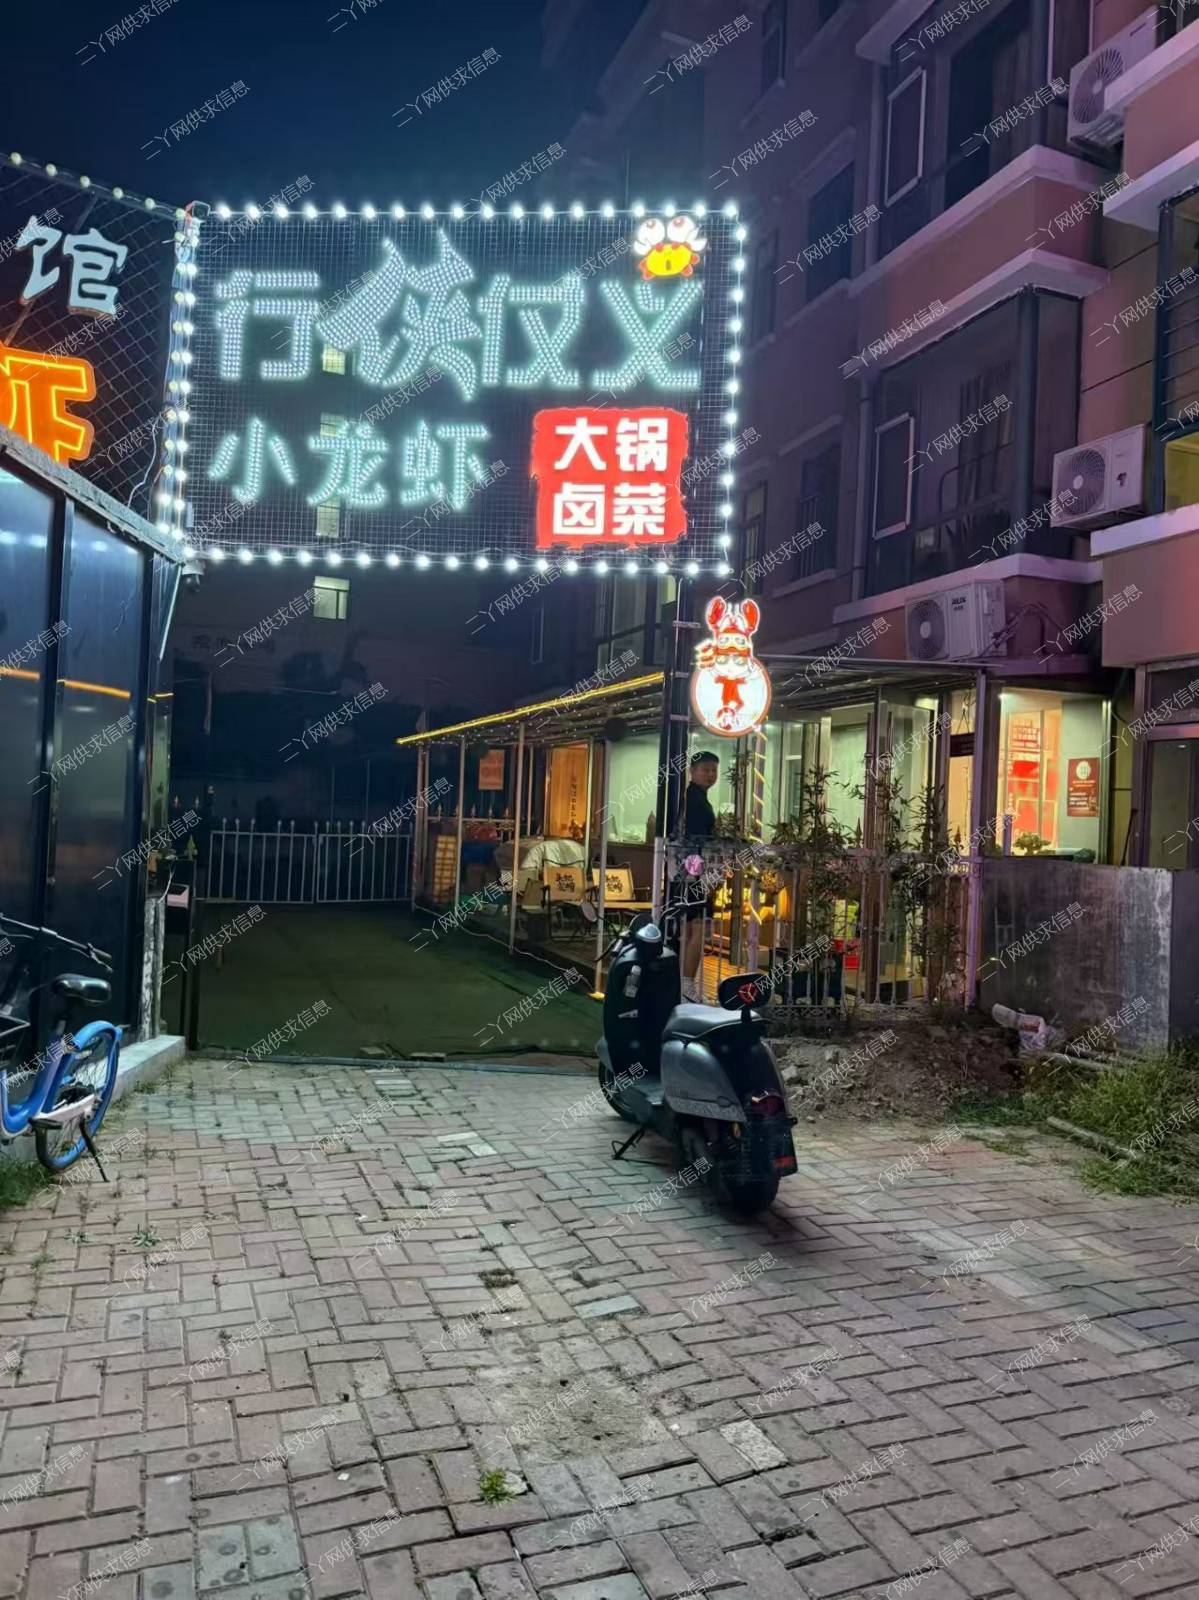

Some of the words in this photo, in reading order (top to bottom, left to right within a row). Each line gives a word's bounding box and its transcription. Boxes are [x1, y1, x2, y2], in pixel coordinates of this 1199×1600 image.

[15, 215, 128, 315] 馆
[207, 416, 490, 510] 小龙虾
[554, 416, 670, 472] 大锅
[552, 483, 667, 537] 卤菜
